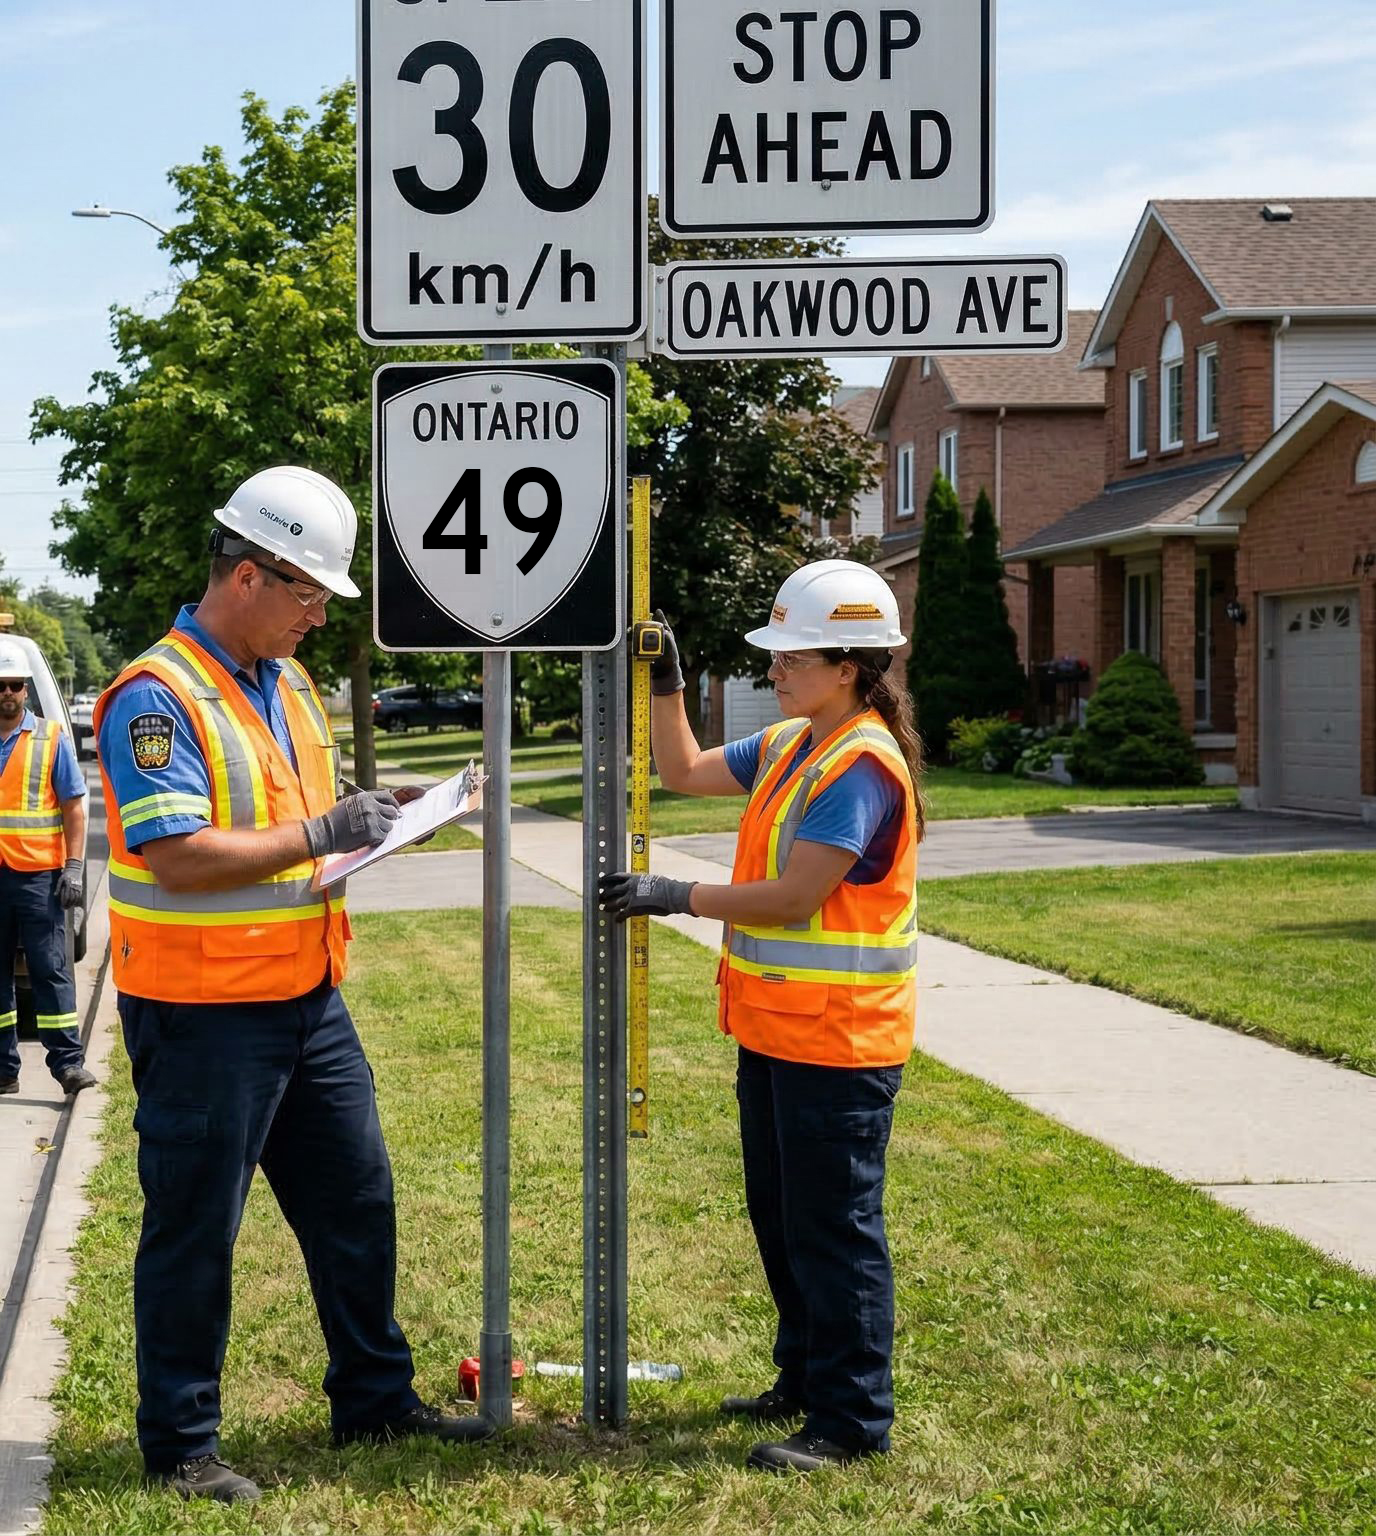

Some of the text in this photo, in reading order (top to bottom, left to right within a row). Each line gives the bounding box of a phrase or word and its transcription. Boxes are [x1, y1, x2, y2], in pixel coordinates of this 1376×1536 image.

[733, 9, 922, 84] STOP
[392, 37, 611, 215] 30
[701, 109, 952, 184] AHEAD
[408, 243, 596, 310] km/h
[682, 275, 1049, 340] OAKWOOD AVE
[412, 401, 579, 443] ONTARIO
[422, 466, 563, 576] 49
